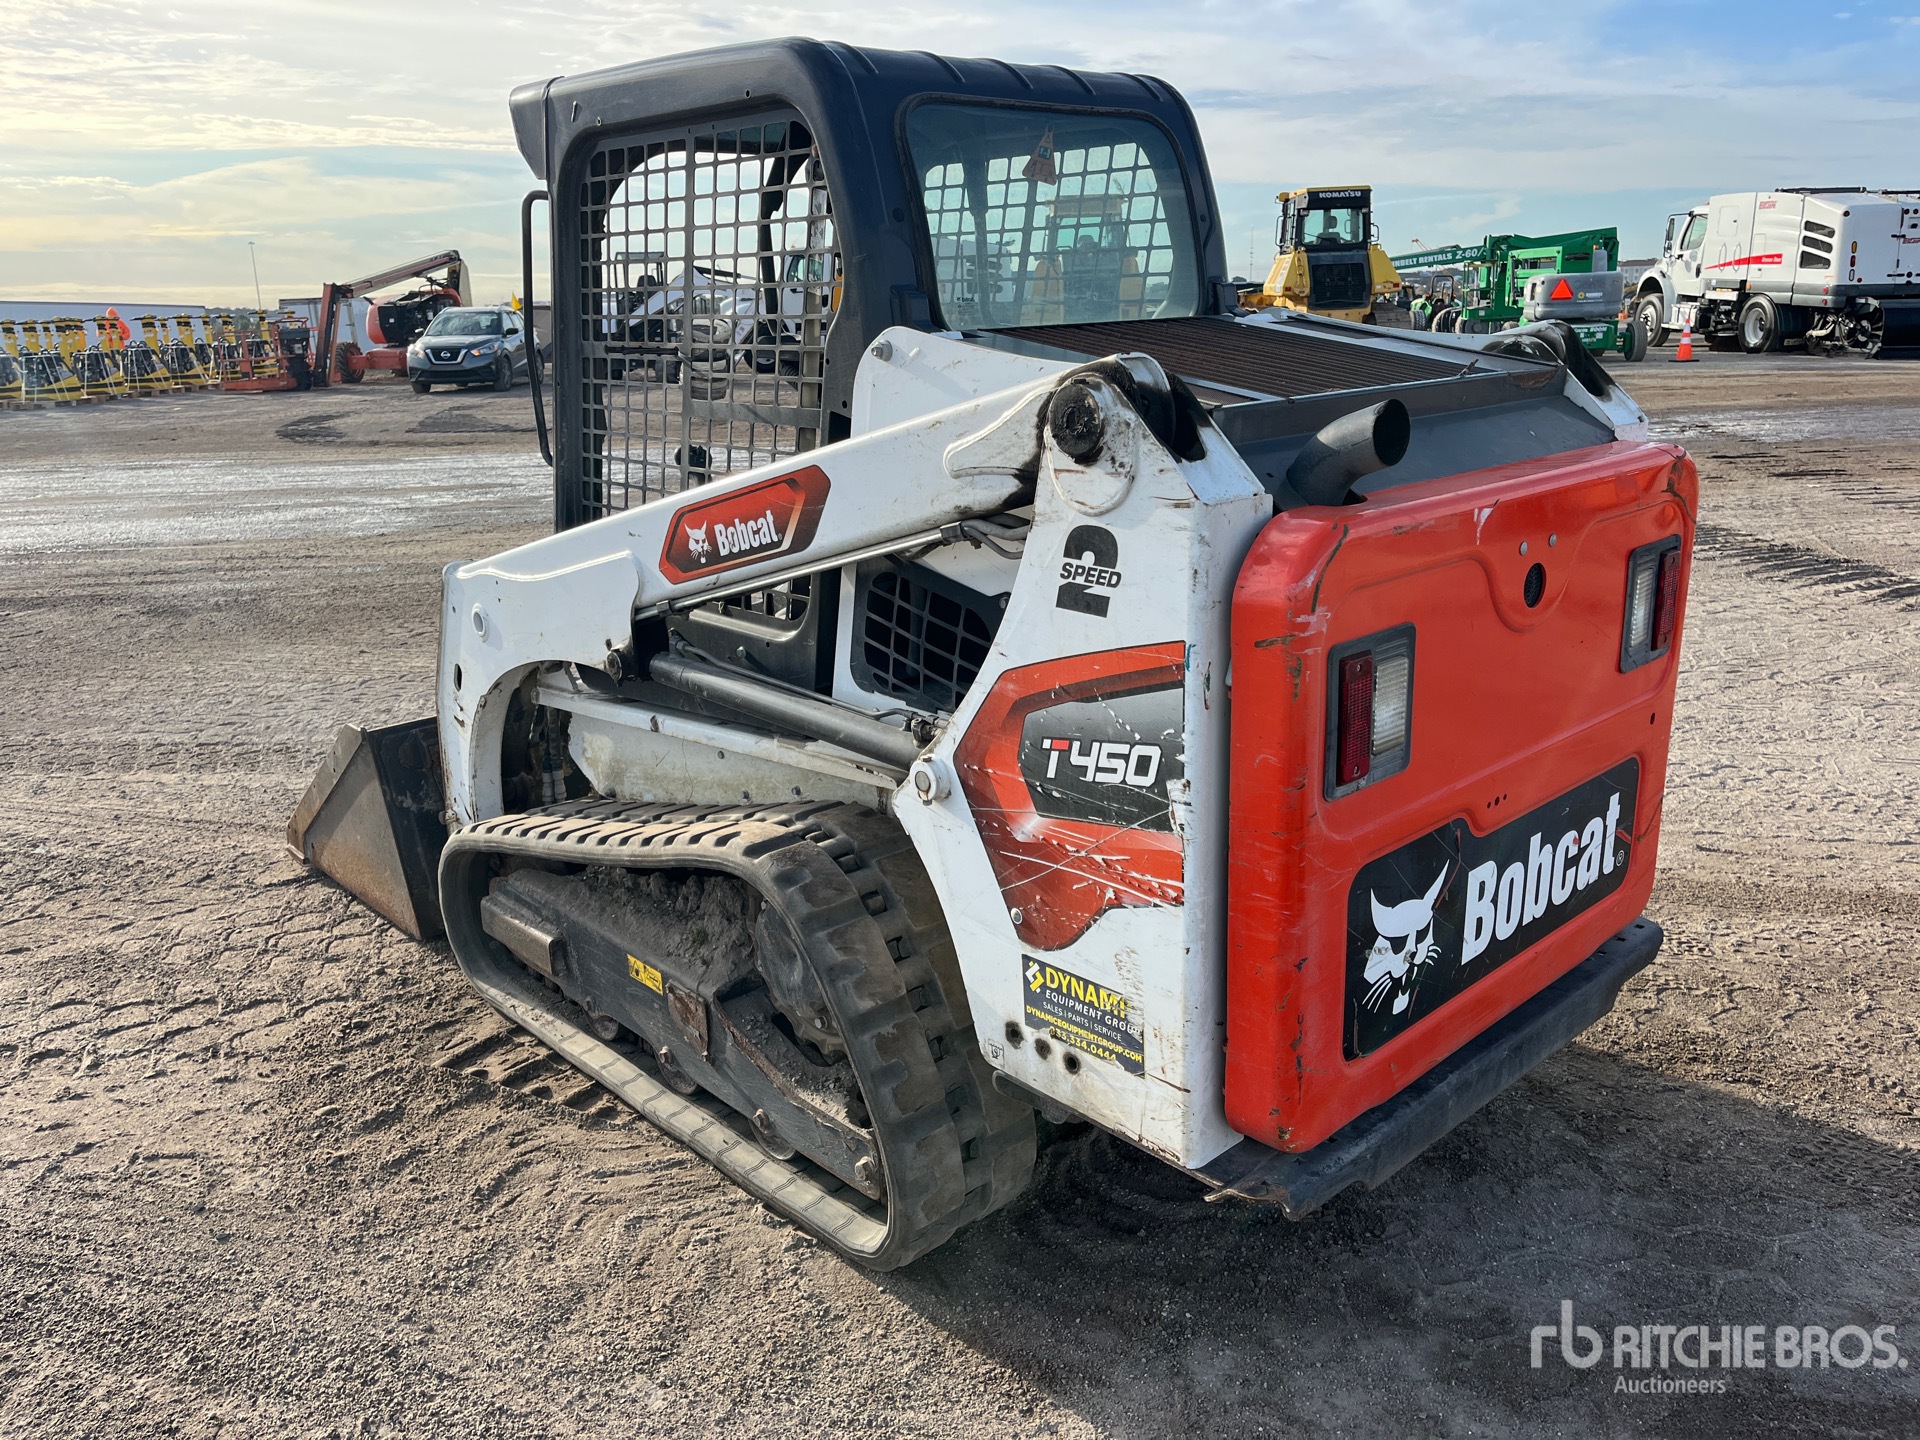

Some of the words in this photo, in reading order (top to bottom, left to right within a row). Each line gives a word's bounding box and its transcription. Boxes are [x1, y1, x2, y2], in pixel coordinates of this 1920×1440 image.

[1319, 190, 1361, 199] KOMATSU
[1419, 252, 1453, 264] RENTALS
[1060, 562, 1122, 589] SPEED
[1042, 738, 1163, 787] T450
[1045, 966, 1129, 1019] DYNAMI
[1045, 989, 1102, 1020] EQUIPMENT
[1105, 1015, 1139, 1036] GROU
[1026, 1005, 1143, 1063] DYNAMICEQUIPMENTGROUP.COM
[1042, 1001, 1063, 1016] SALES
[1067, 1012, 1089, 1027] PARTS
[1094, 1023, 1122, 1042] SERVICE
